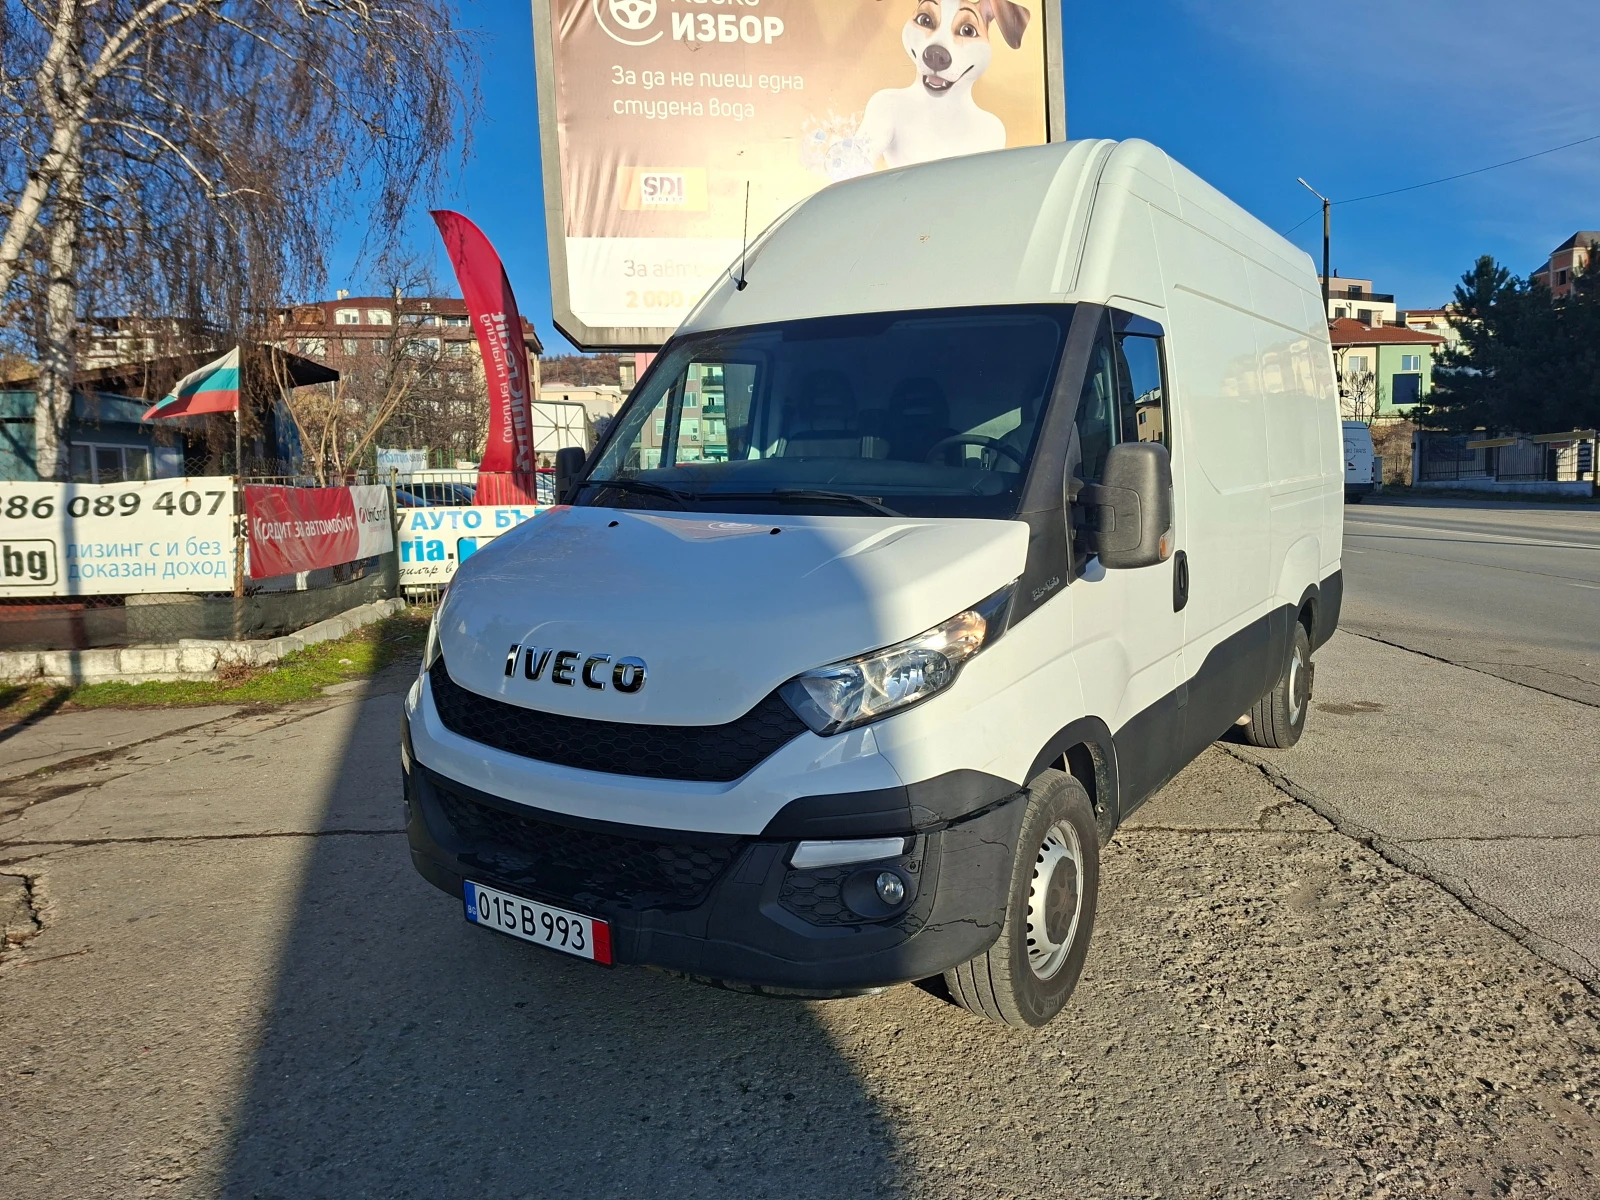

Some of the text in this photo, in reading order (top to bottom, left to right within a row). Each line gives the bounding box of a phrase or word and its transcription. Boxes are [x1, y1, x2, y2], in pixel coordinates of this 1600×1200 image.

[671, 12, 785, 45] ИЗБОР
[611, 65, 804, 94] За да не пиеш една
[613, 97, 755, 122] студена вода
[643, 176, 683, 197] SDI
[623, 259, 648, 278] За
[0, 490, 227, 519] 86 089 407
[252, 517, 292, 545] Кредит
[304, 513, 355, 538] автомобил
[410, 509, 482, 531] АУТО
[494, 508, 547, 528] БЪ
[66, 536, 222, 558] лизинг с и без
[68, 560, 228, 582] доказан доход
[504, 643, 649, 695] IVECO
[467, 904, 477, 916] BG
